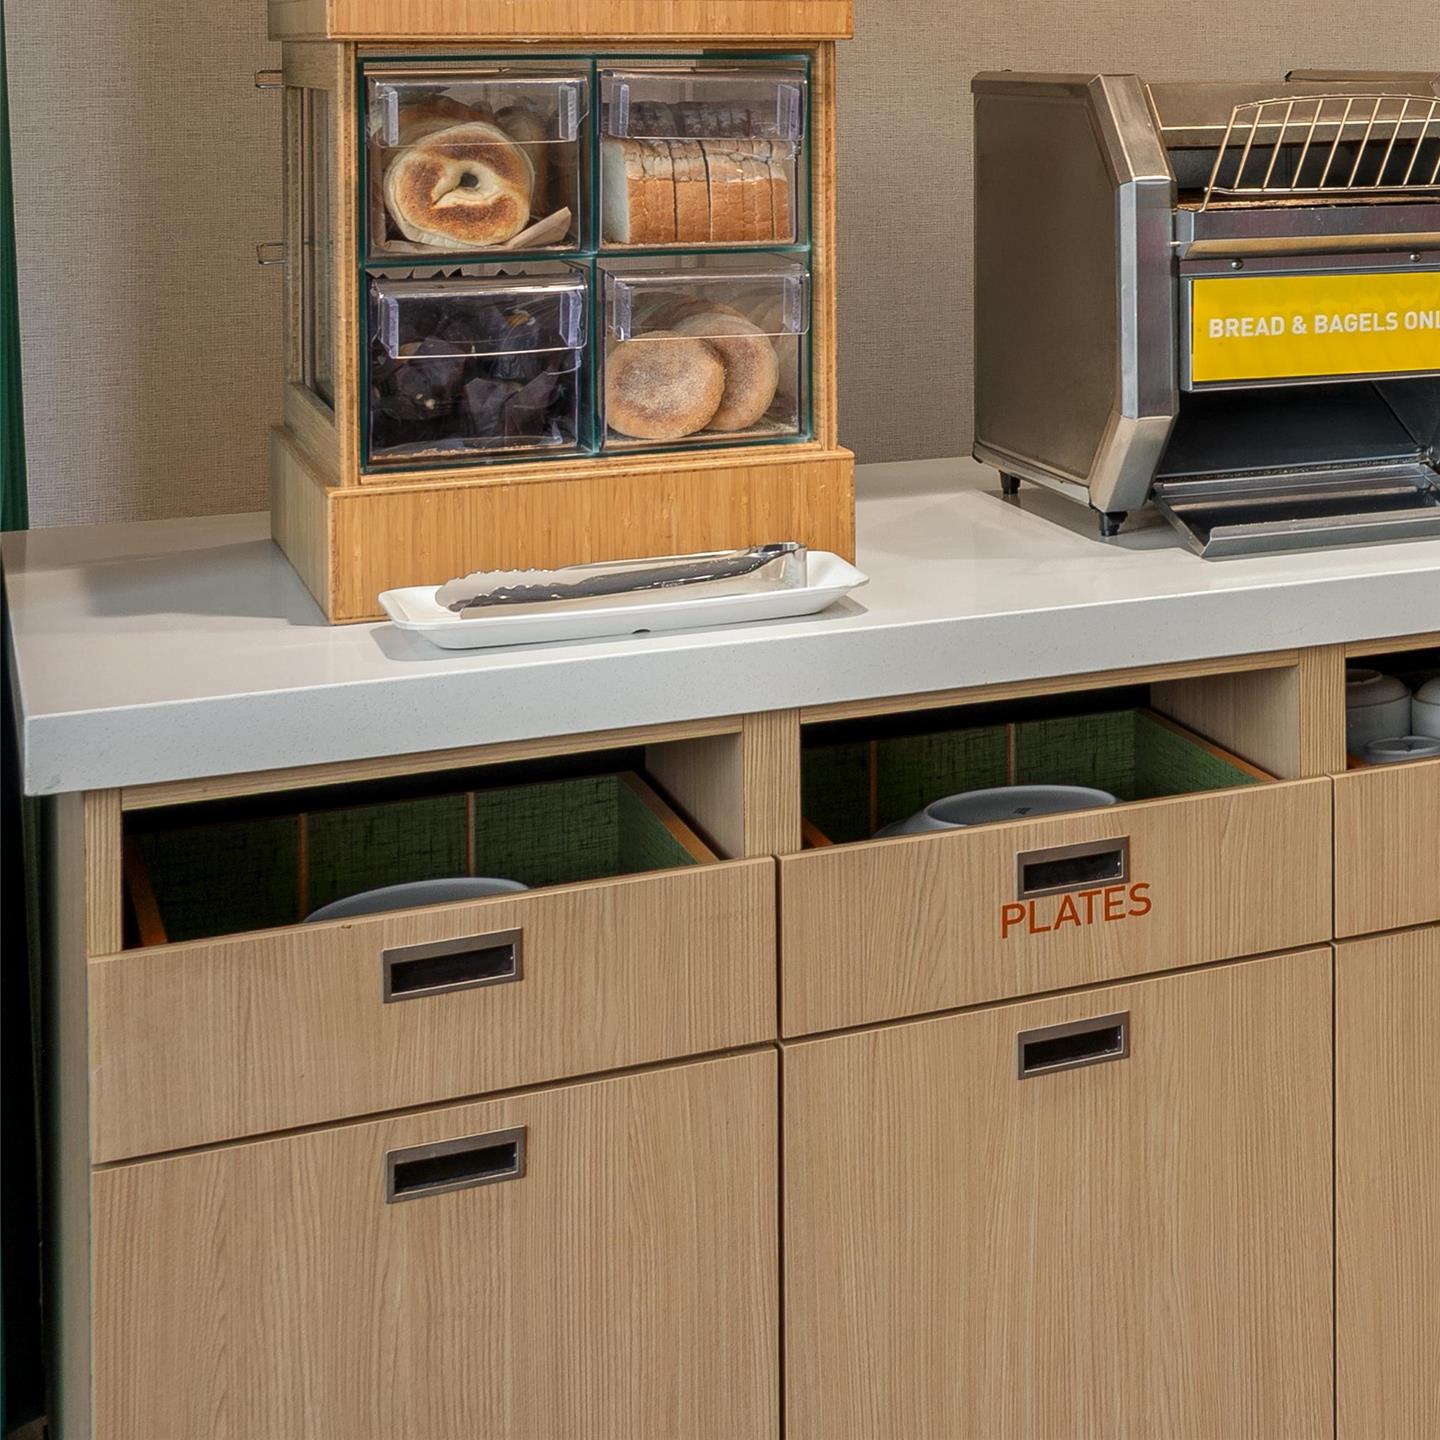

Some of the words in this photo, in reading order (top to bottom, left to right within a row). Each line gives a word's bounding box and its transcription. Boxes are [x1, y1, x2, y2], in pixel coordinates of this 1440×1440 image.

[1209, 316, 1285, 338] BREAD
[1292, 316, 1307, 334] &
[1314, 311, 1398, 334] BAGELS
[1000, 880, 1152, 938] PLATES
